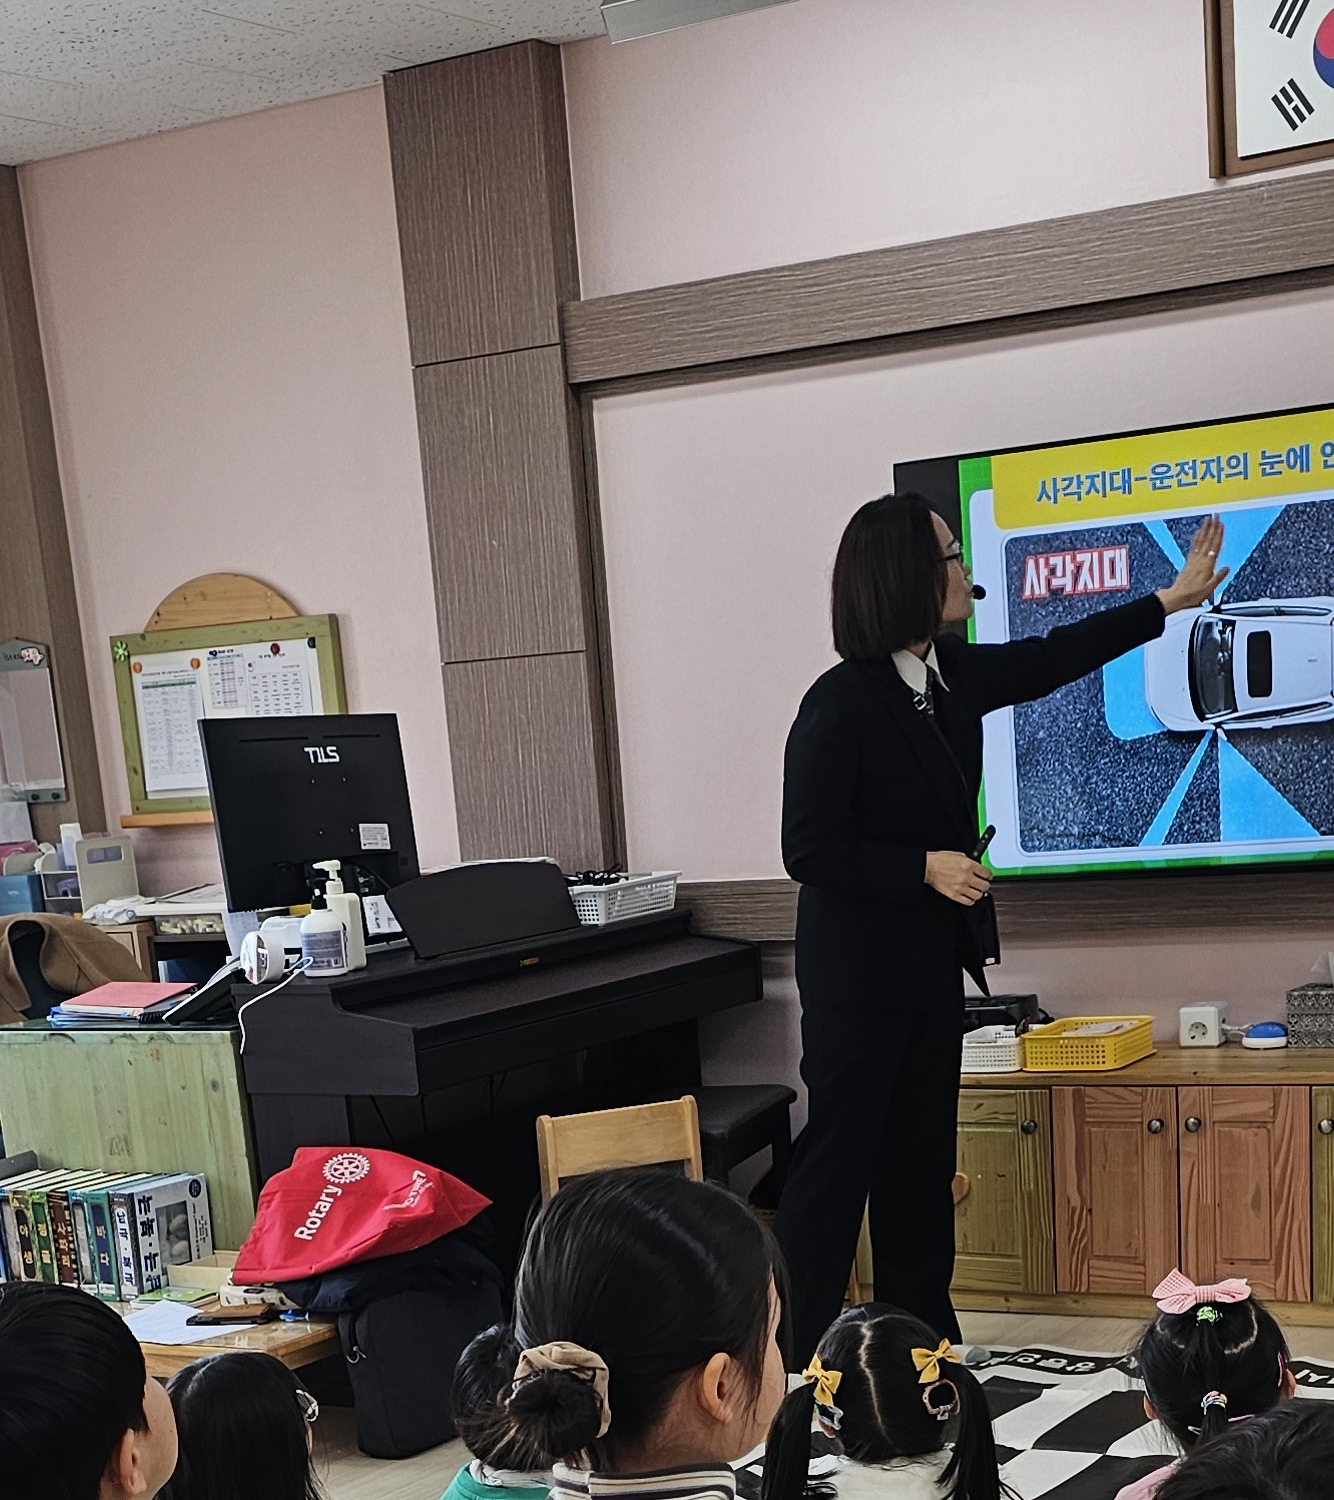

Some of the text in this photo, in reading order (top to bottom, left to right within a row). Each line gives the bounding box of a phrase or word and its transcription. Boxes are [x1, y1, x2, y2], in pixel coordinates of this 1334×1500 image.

[1036, 452, 1250, 505] 사각지대-운전자의
[1258, 443, 1311, 478] 눈에
[1023, 546, 1129, 599] 사각지대
[304, 746, 340, 763] TILS
[294, 1184, 343, 1241] Rotary
[96, 1225, 110, 1266] 바다
